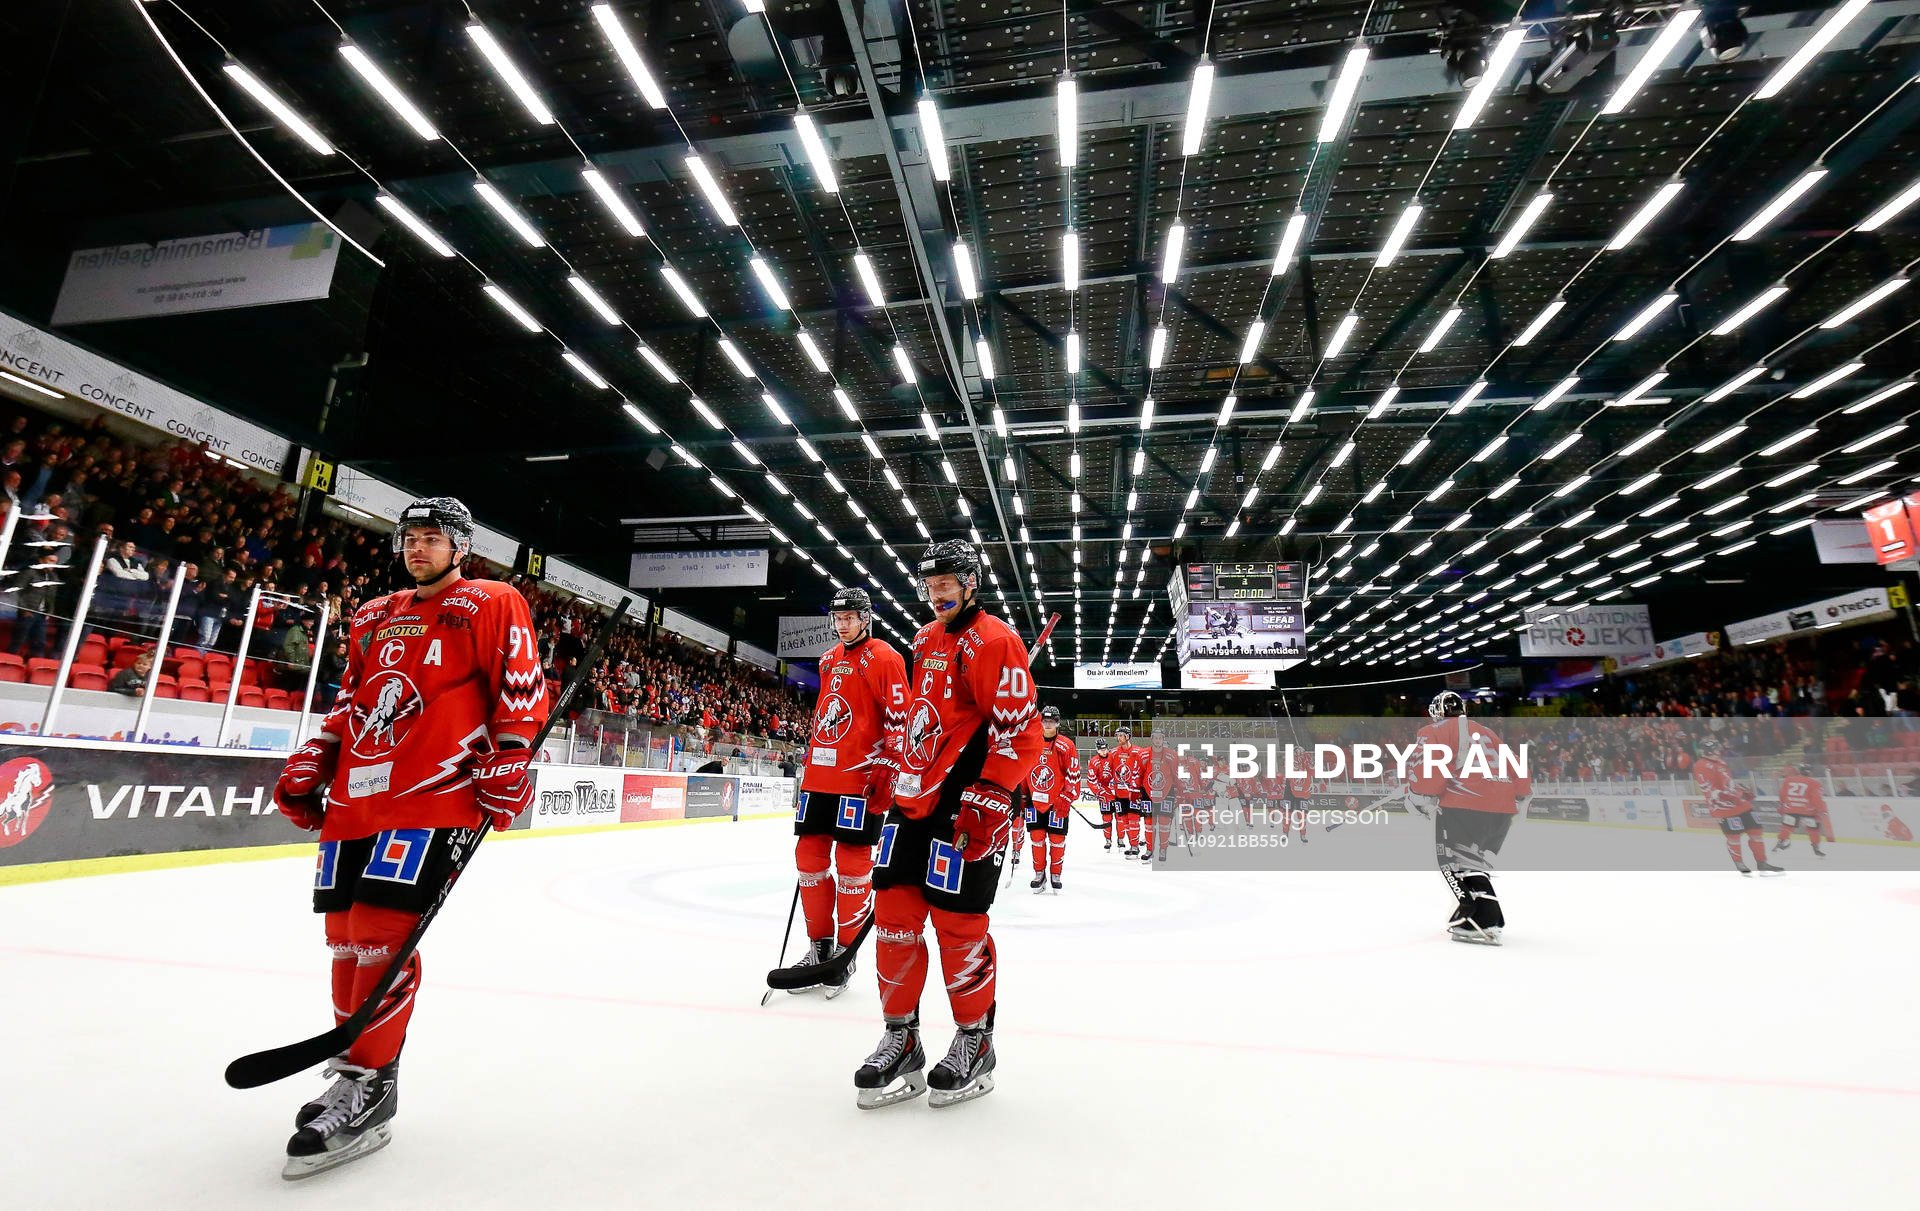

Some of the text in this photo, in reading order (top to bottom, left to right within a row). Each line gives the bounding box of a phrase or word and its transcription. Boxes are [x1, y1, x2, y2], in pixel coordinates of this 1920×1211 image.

[0, 350, 65, 383] NCENT
[80, 383, 155, 420] CONCENT
[166, 419, 230, 451] CONCENT
[241, 449, 284, 473] CONCE
[338, 487, 366, 504] ONCENT
[1880, 519, 1896, 540] 1
[545, 573, 558, 583] CENT
[1215, 564, 1222, 574] H
[1235, 564, 1254, 574] 5-2
[1267, 564, 1274, 574] G
[561, 579, 584, 593] CONCENT
[1233, 588, 1264, 599] 20:00
[1262, 616, 1295, 625] SEFAB
[780, 637, 806, 652] HAGA
[808, 631, 831, 646] R.O.T.
[1198, 647, 1206, 655] Vi
[1208, 646, 1238, 657] bygger
[1256, 646, 1299, 656] framtiden
[423, 639, 442, 667] A
[996, 667, 1029, 698] 20
[891, 683, 904, 705] 5
[1788, 783, 1808, 796] 27
[87, 784, 282, 820] VITAH
[539, 791, 573, 815] PUB
[838, 885, 866, 895] bladet
[1440, 863, 1466, 900] Reebok
